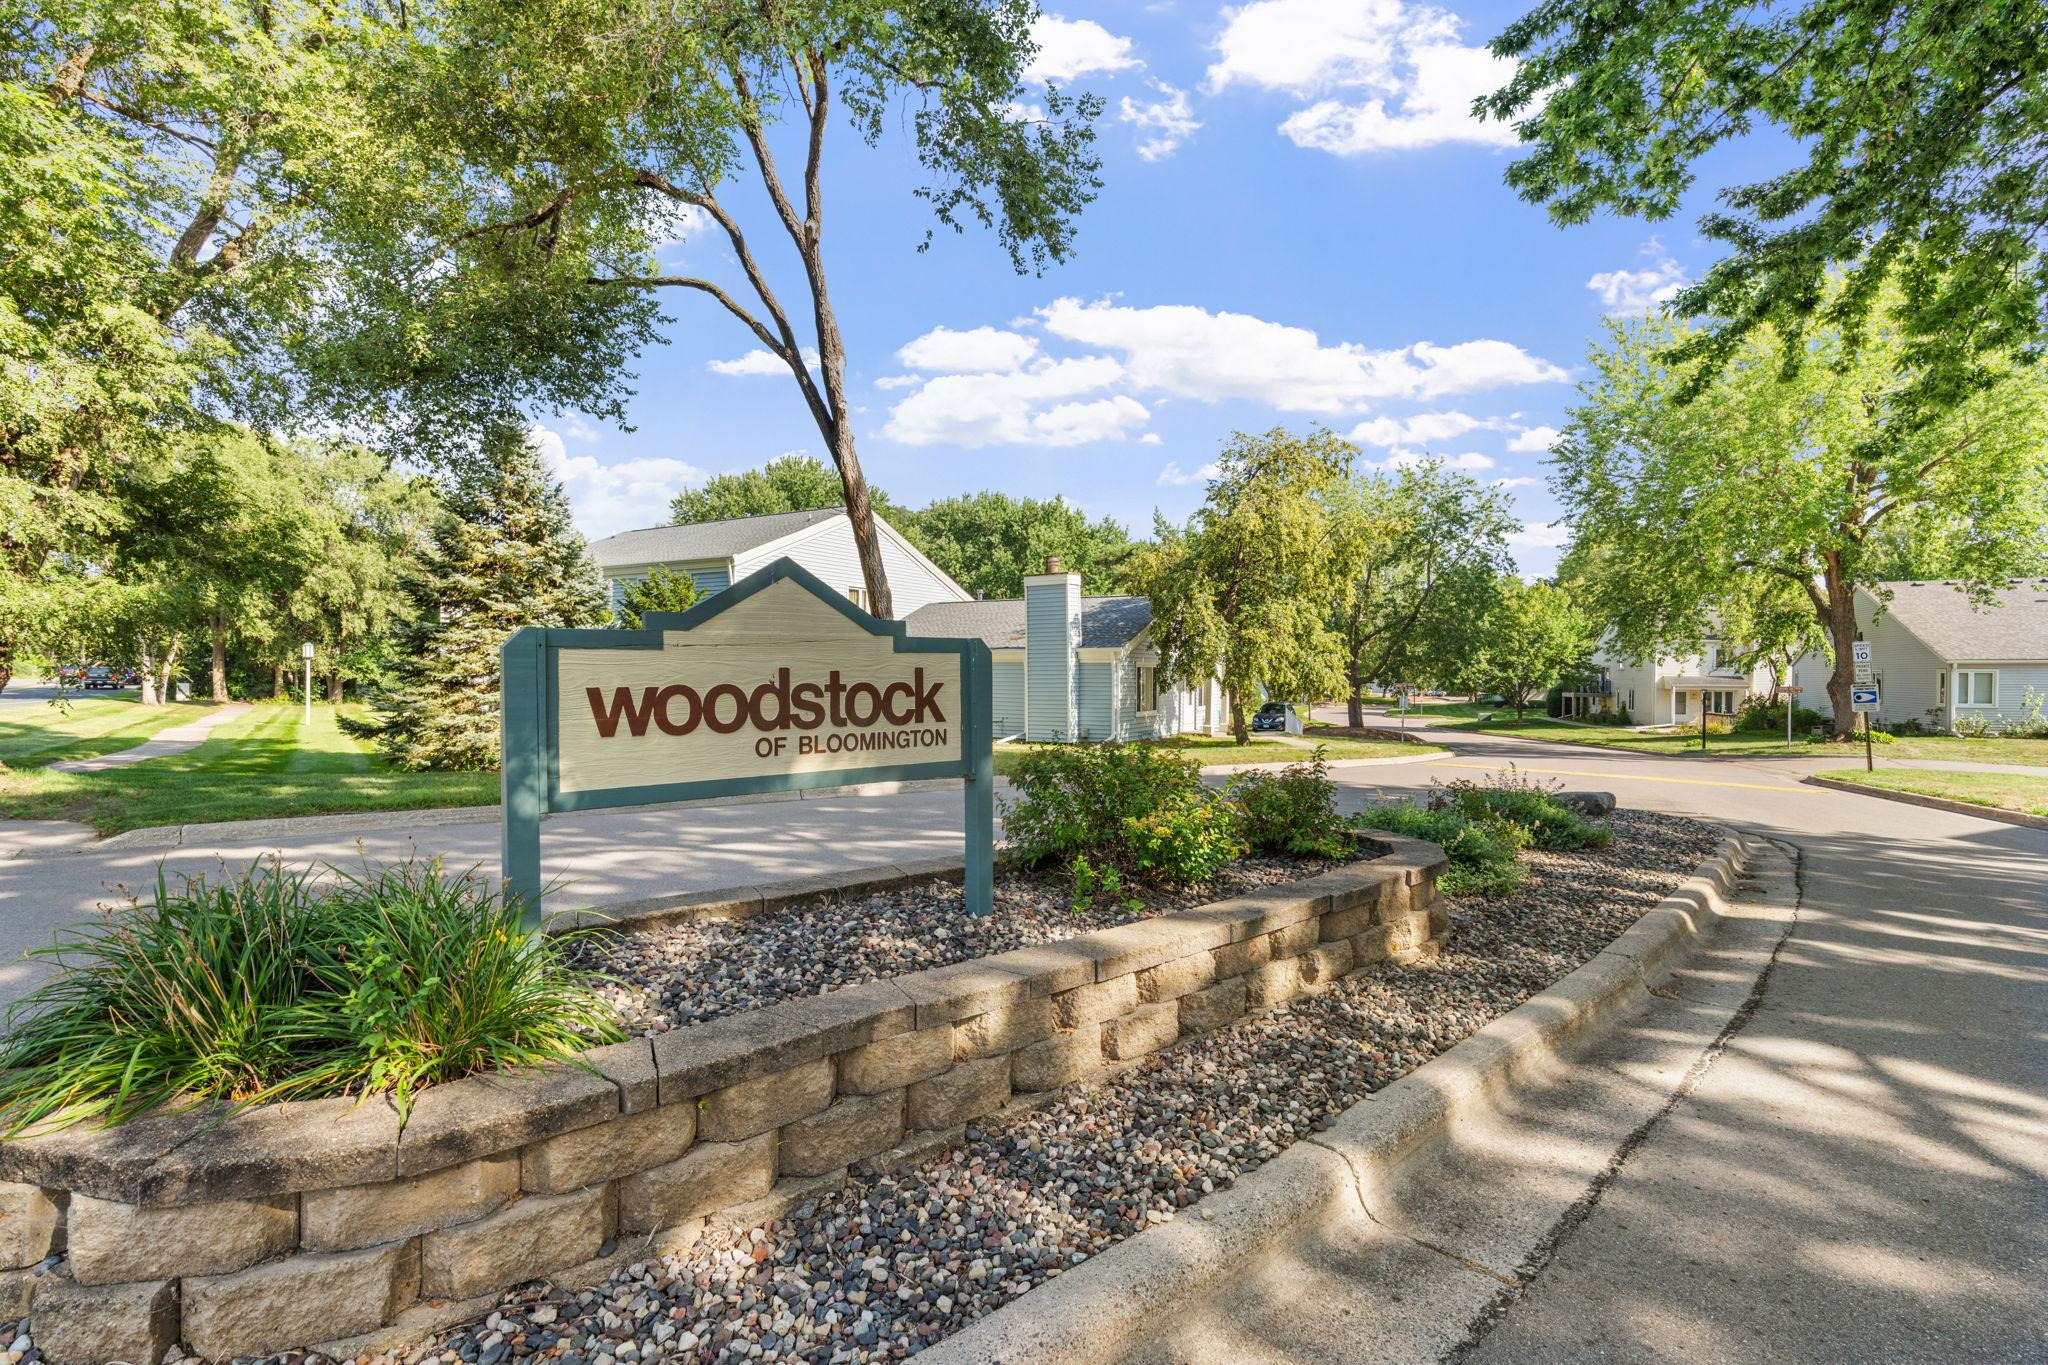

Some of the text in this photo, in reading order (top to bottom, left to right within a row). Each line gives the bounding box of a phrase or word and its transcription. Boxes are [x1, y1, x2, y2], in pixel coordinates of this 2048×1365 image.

[586, 667, 947, 737] woodstock
[755, 729, 947, 758] OF BLOOMINGTON
